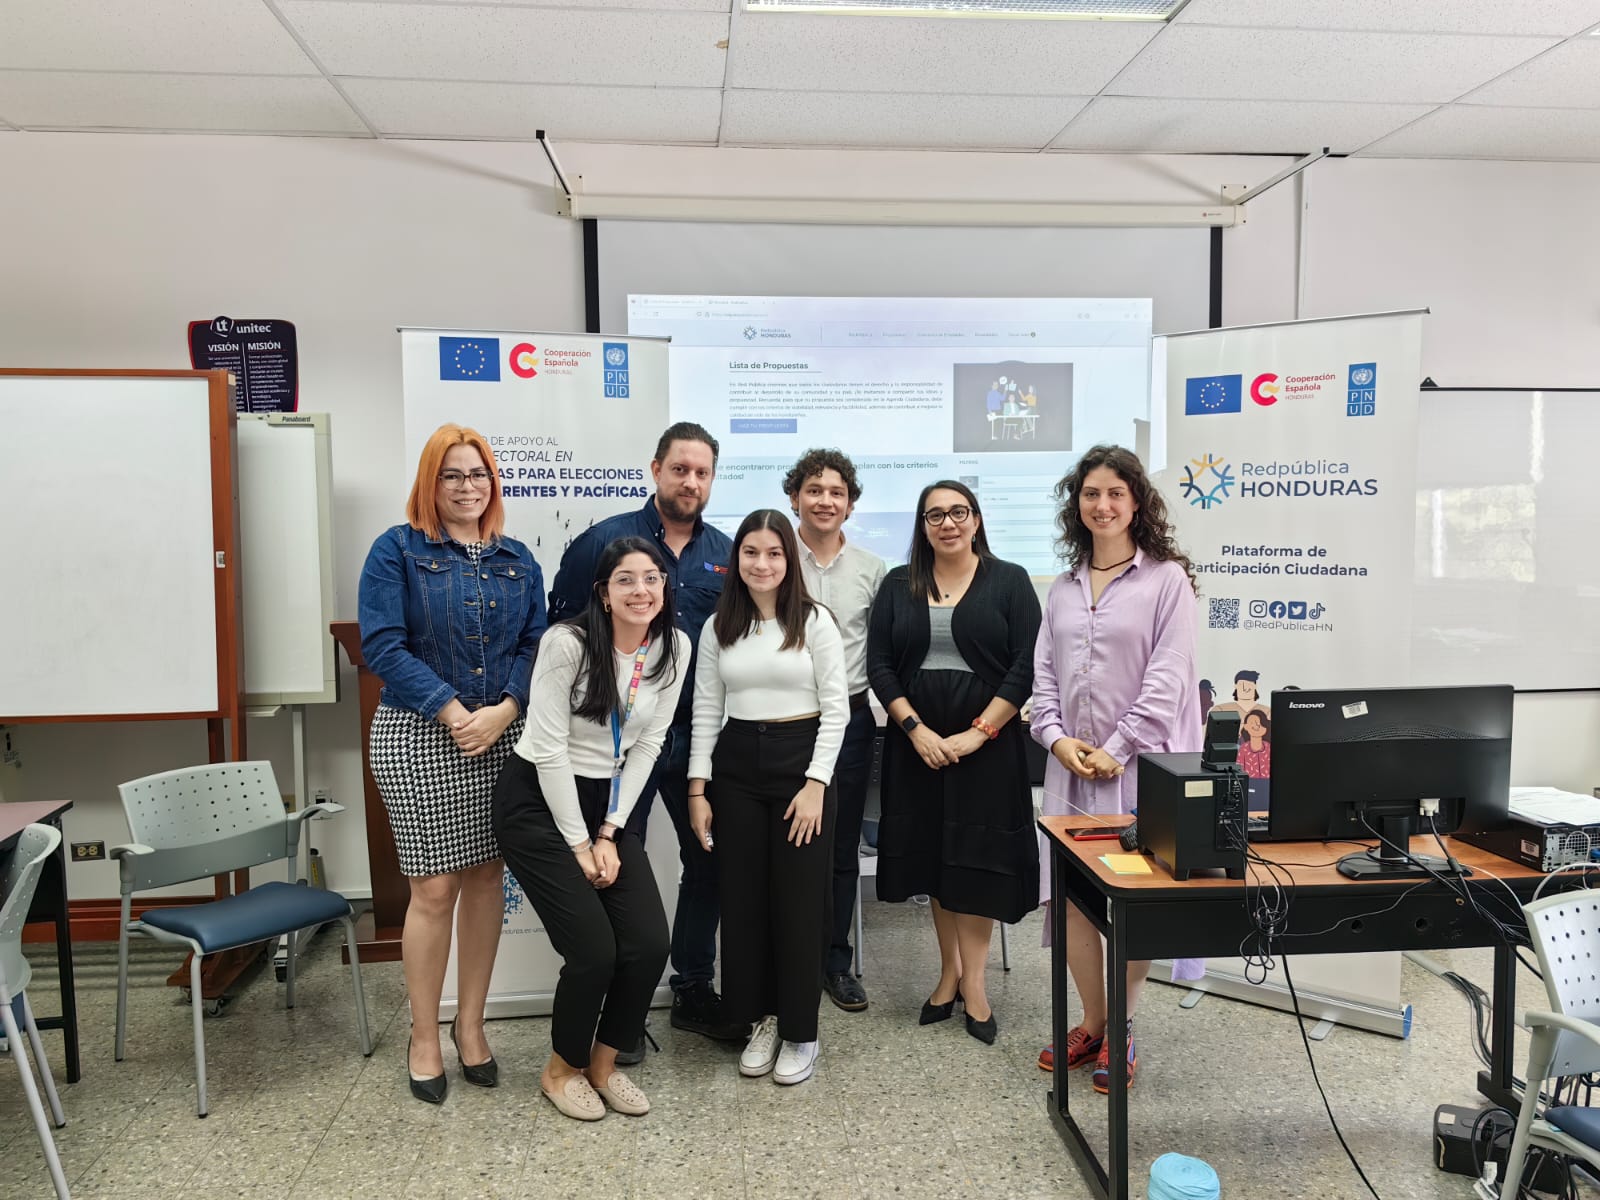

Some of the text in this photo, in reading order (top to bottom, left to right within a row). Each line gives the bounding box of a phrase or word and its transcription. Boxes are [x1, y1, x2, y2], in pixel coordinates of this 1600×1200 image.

[236, 322, 272, 334] unitec
[208, 342, 239, 352] VISIÓN
[247, 340, 281, 351] MISIÓN
[544, 348, 591, 358] Cooperación
[544, 358, 579, 367] Española
[729, 360, 808, 370] Lista de Propuestas
[1285, 373, 1336, 384] Cooperación
[1285, 383, 1321, 394] Española
[491, 436, 504, 446] DE
[507, 436, 543, 446] APOYO
[546, 436, 559, 446] AL
[555, 450, 573, 462] EN
[725, 463, 776, 471] encontraron
[893, 461, 905, 469] los
[906, 460, 939, 469] criterios
[1241, 459, 1350, 478] Redpública
[518, 468, 556, 480] PARA
[559, 468, 644, 480] ELECCIONES
[560, 486, 570, 498] Y
[574, 483, 648, 498] PACÍFICAS
[1240, 479, 1378, 498] HONDURAS
[1221, 545, 1327, 557] Plataforma de
[1284, 562, 1368, 577] Ciudadana
[1243, 620, 1333, 633] @RedPublicaHN
[1288, 701, 1326, 709] lenovo
